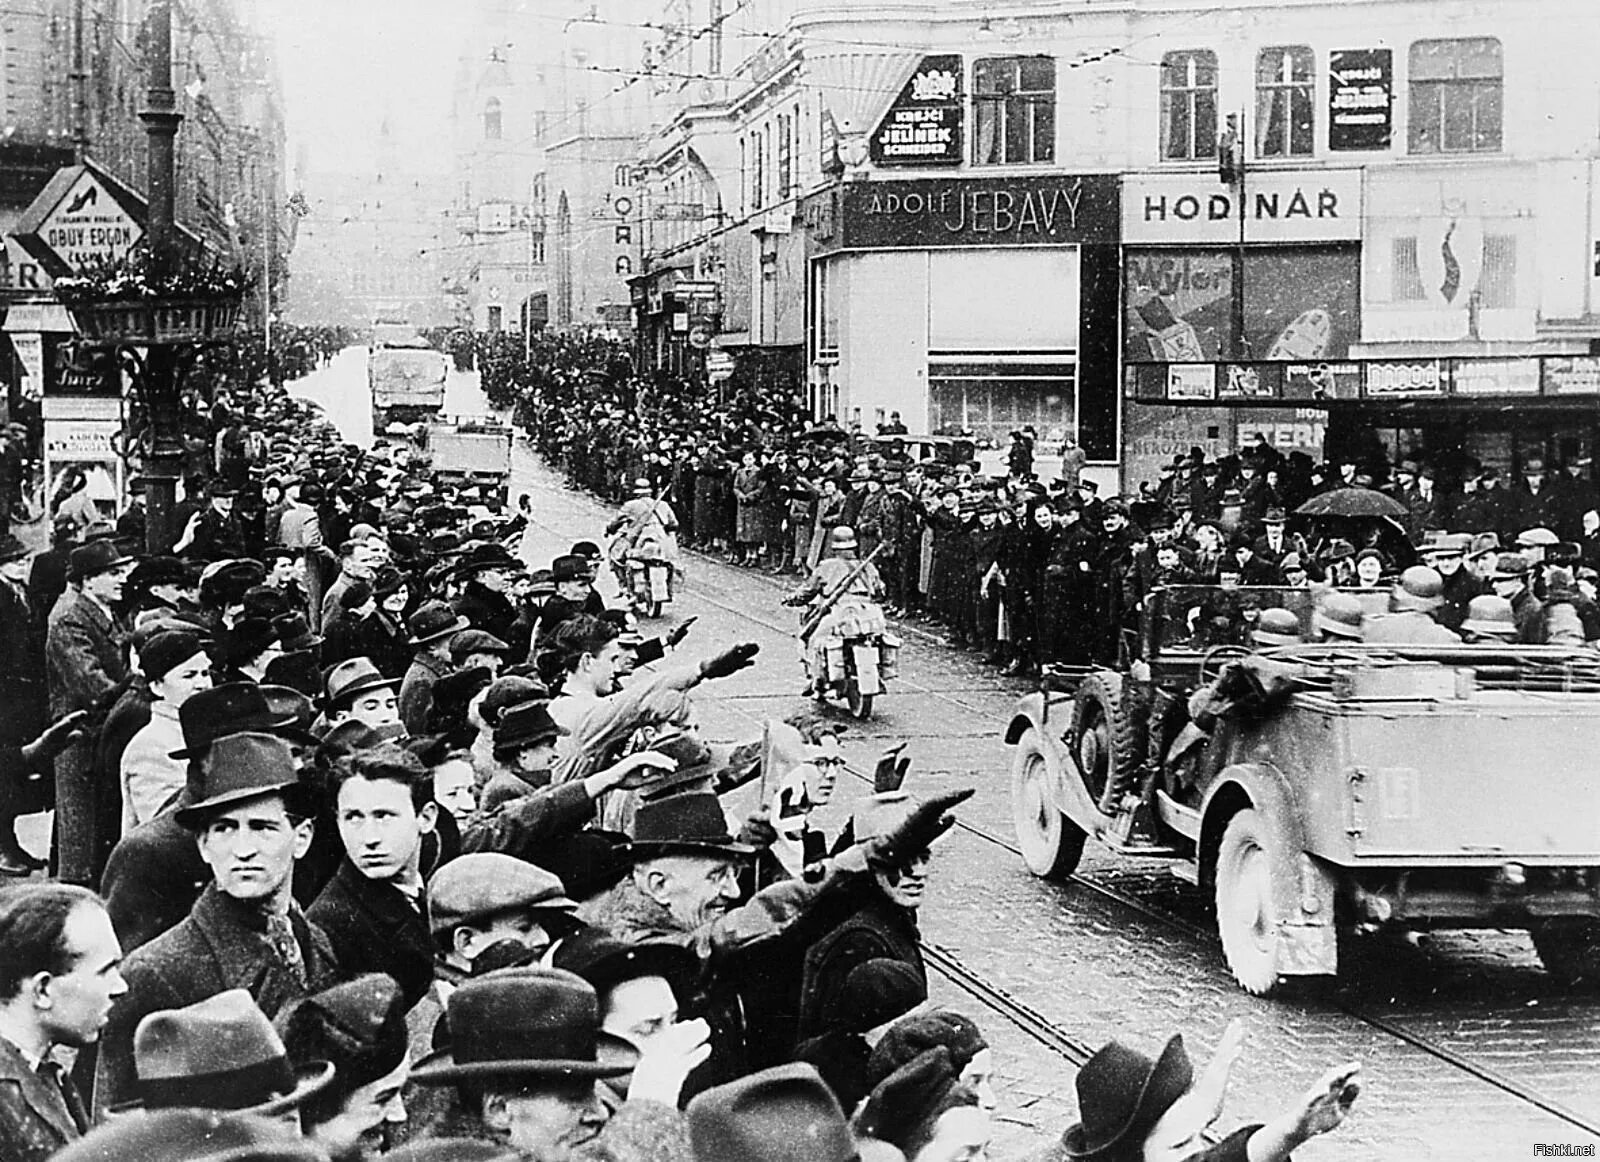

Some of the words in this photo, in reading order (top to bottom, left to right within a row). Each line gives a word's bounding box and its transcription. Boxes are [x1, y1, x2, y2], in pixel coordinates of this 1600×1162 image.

[870, 189, 951, 214] ADOLF
[945, 177, 1082, 233] JEBAVÝ
[48, 228, 85, 247] OBUV
